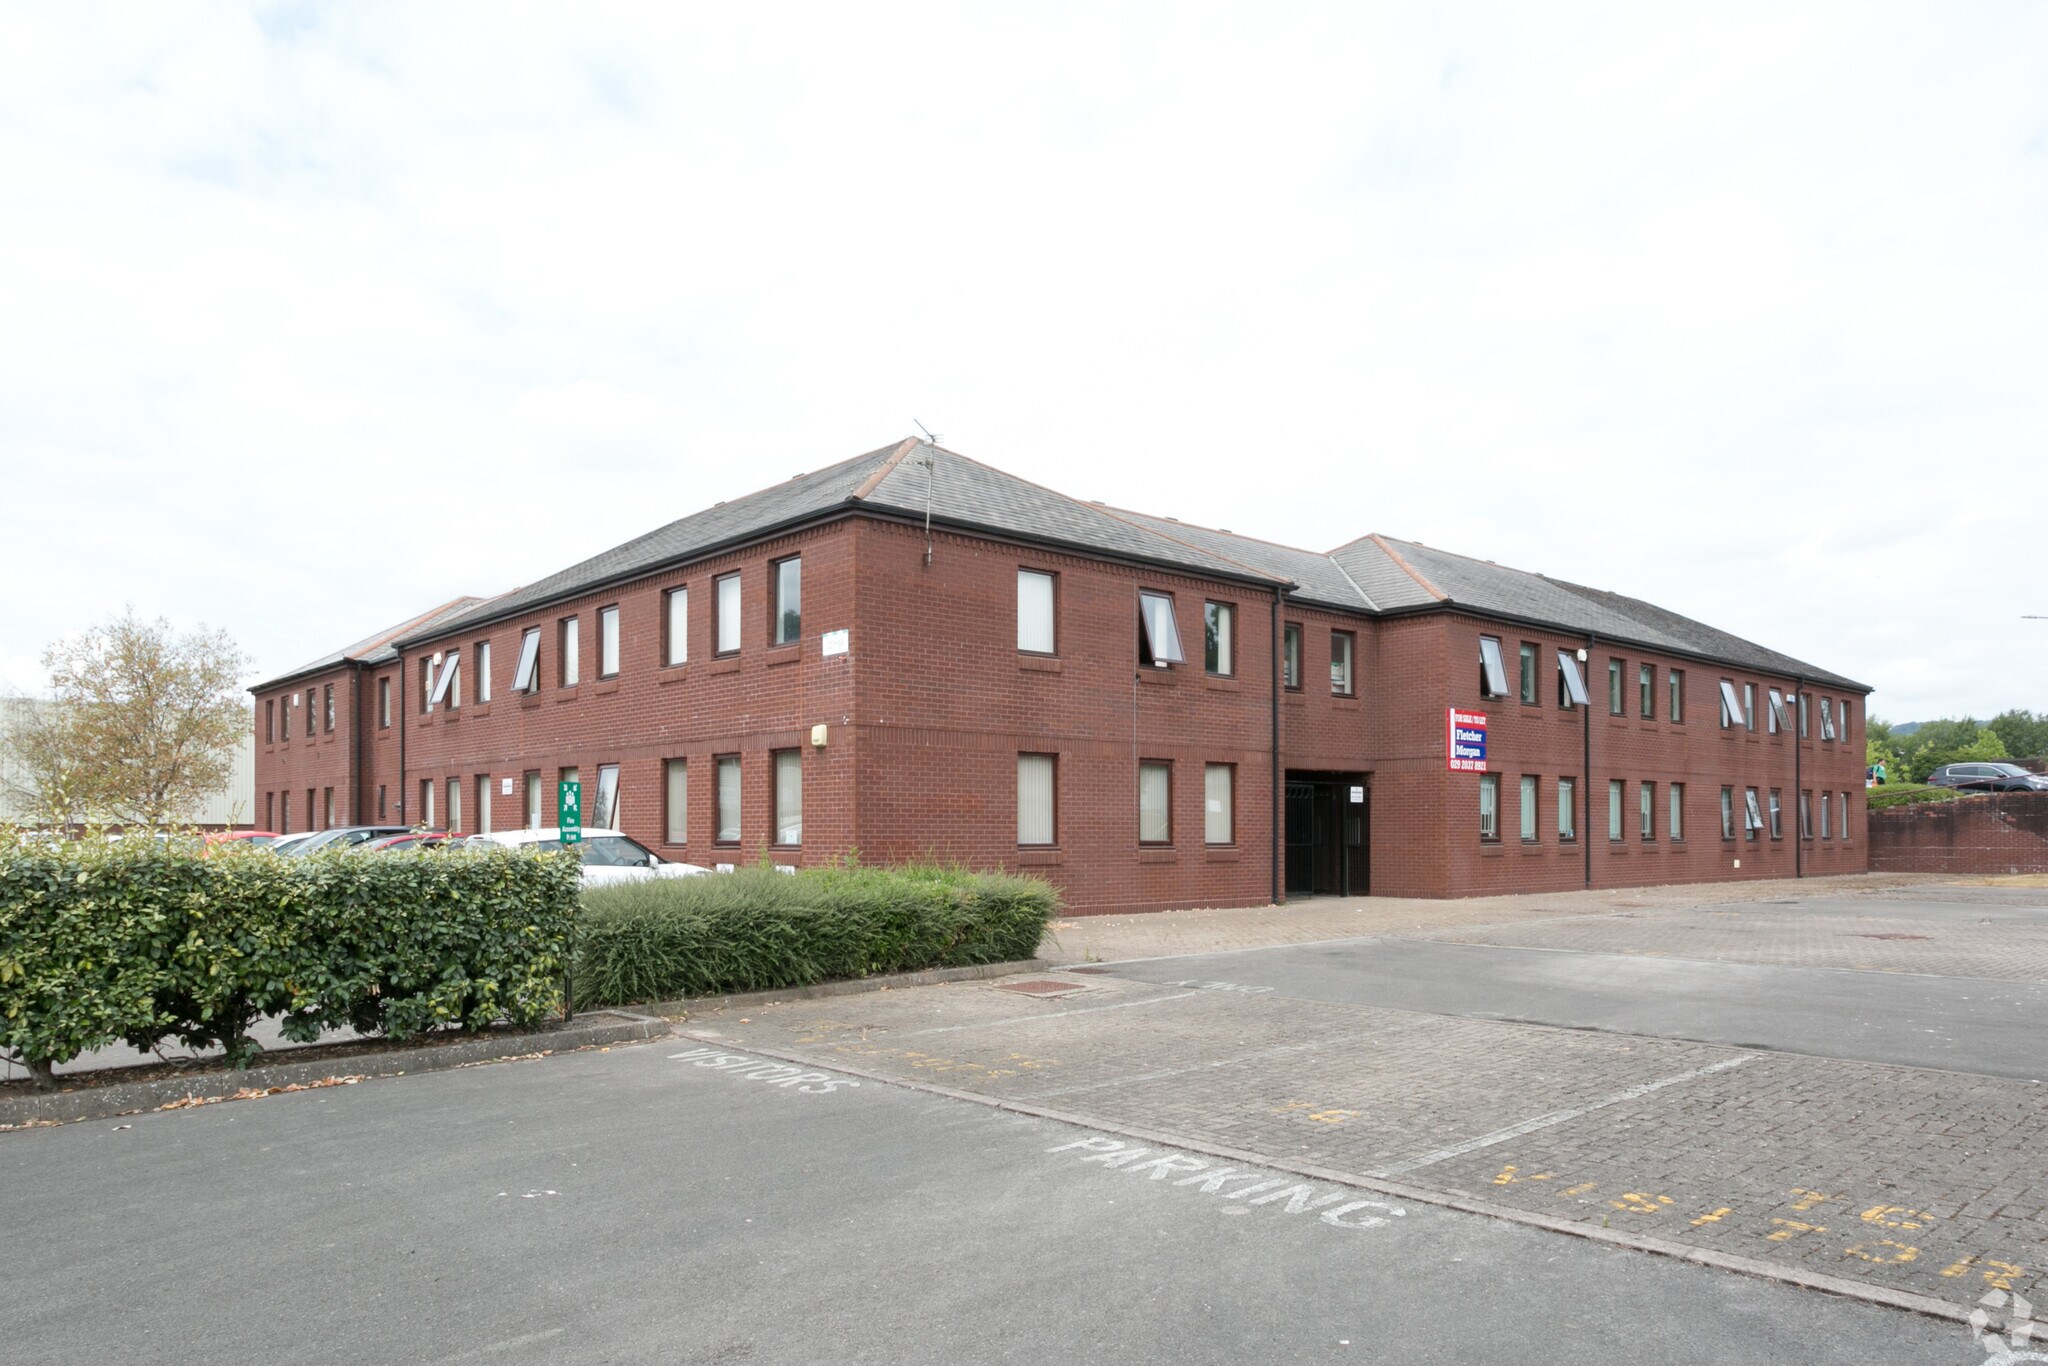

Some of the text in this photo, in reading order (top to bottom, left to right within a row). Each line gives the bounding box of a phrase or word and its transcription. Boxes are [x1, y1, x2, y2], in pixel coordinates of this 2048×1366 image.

[1456, 729, 1482, 742] Fletcher
[1456, 745, 1480, 758] Morgan
[1450, 759, 1461, 769] 029
[666, 1047, 861, 1094] VISITORS
[1044, 1136, 1407, 1229] PARKING
